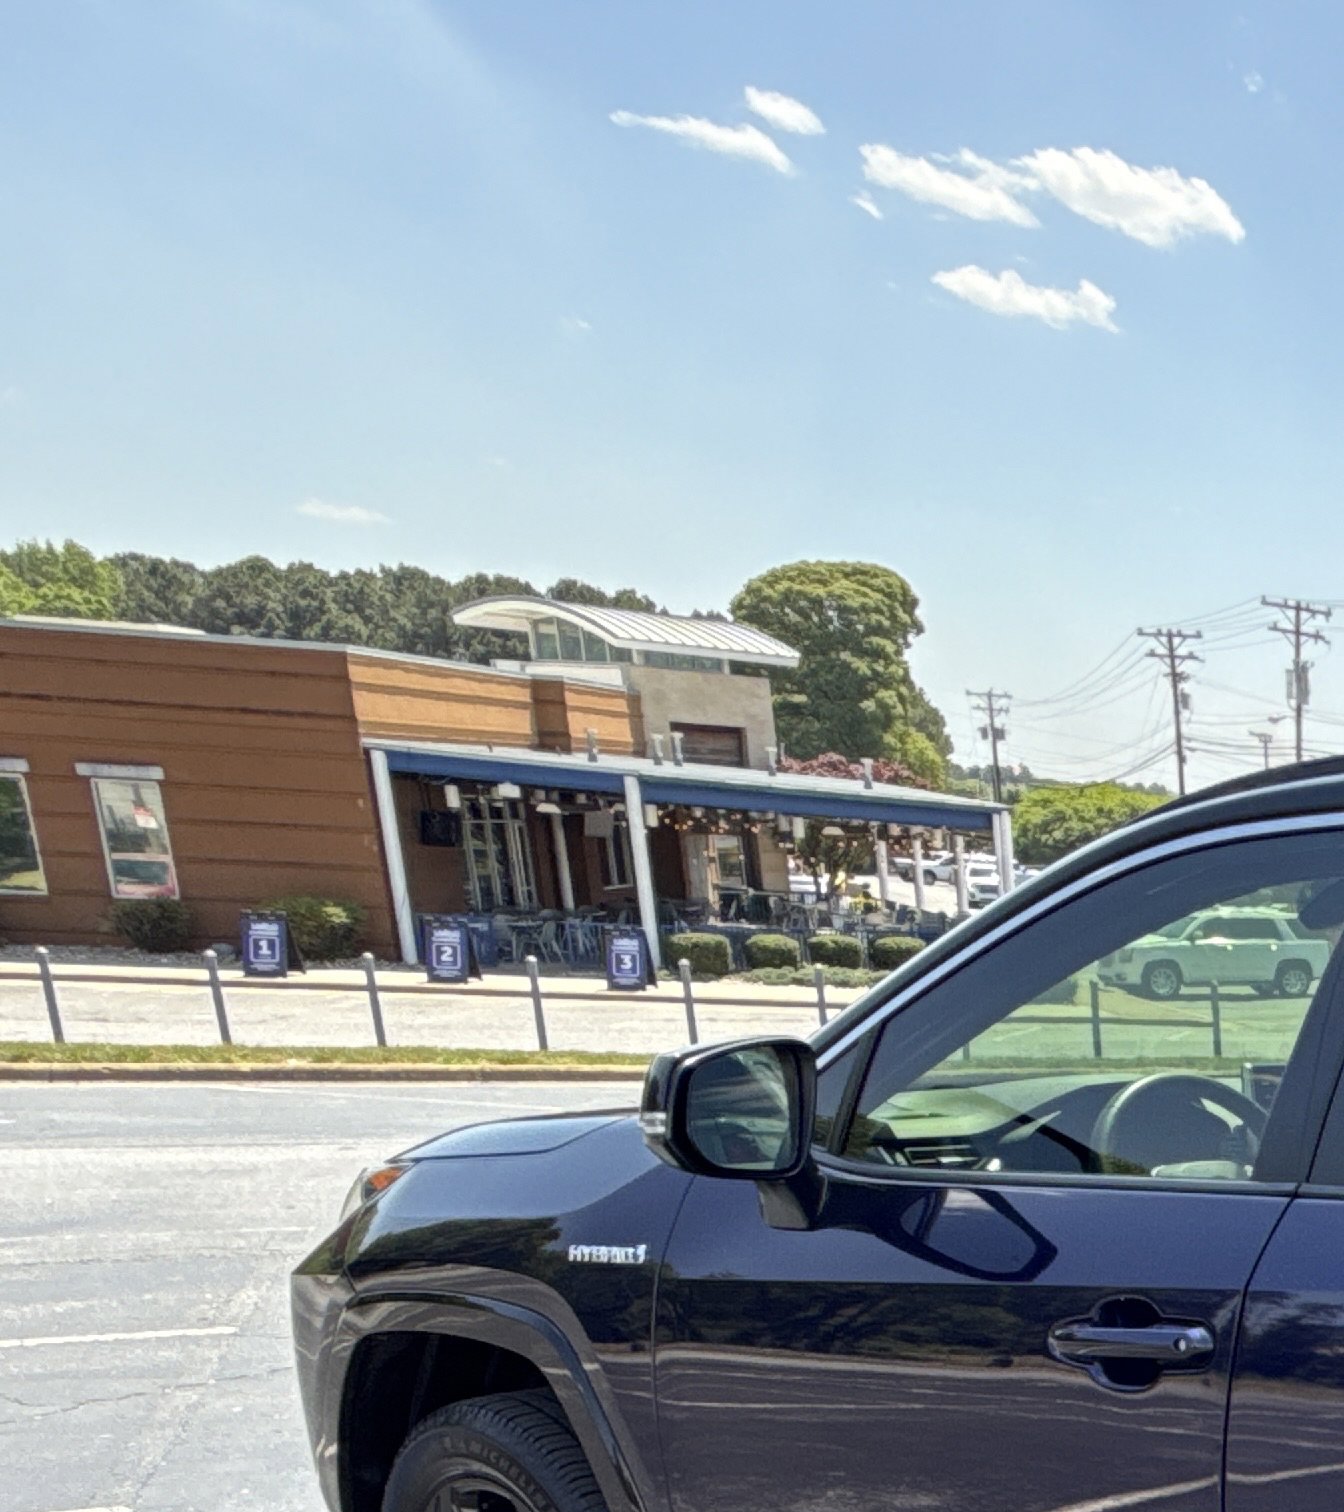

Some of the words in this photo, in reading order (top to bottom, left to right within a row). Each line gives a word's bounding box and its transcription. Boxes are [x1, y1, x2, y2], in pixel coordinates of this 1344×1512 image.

[259, 939, 272, 955] 1
[440, 945, 454, 962] 2
[620, 954, 633, 970] 3
